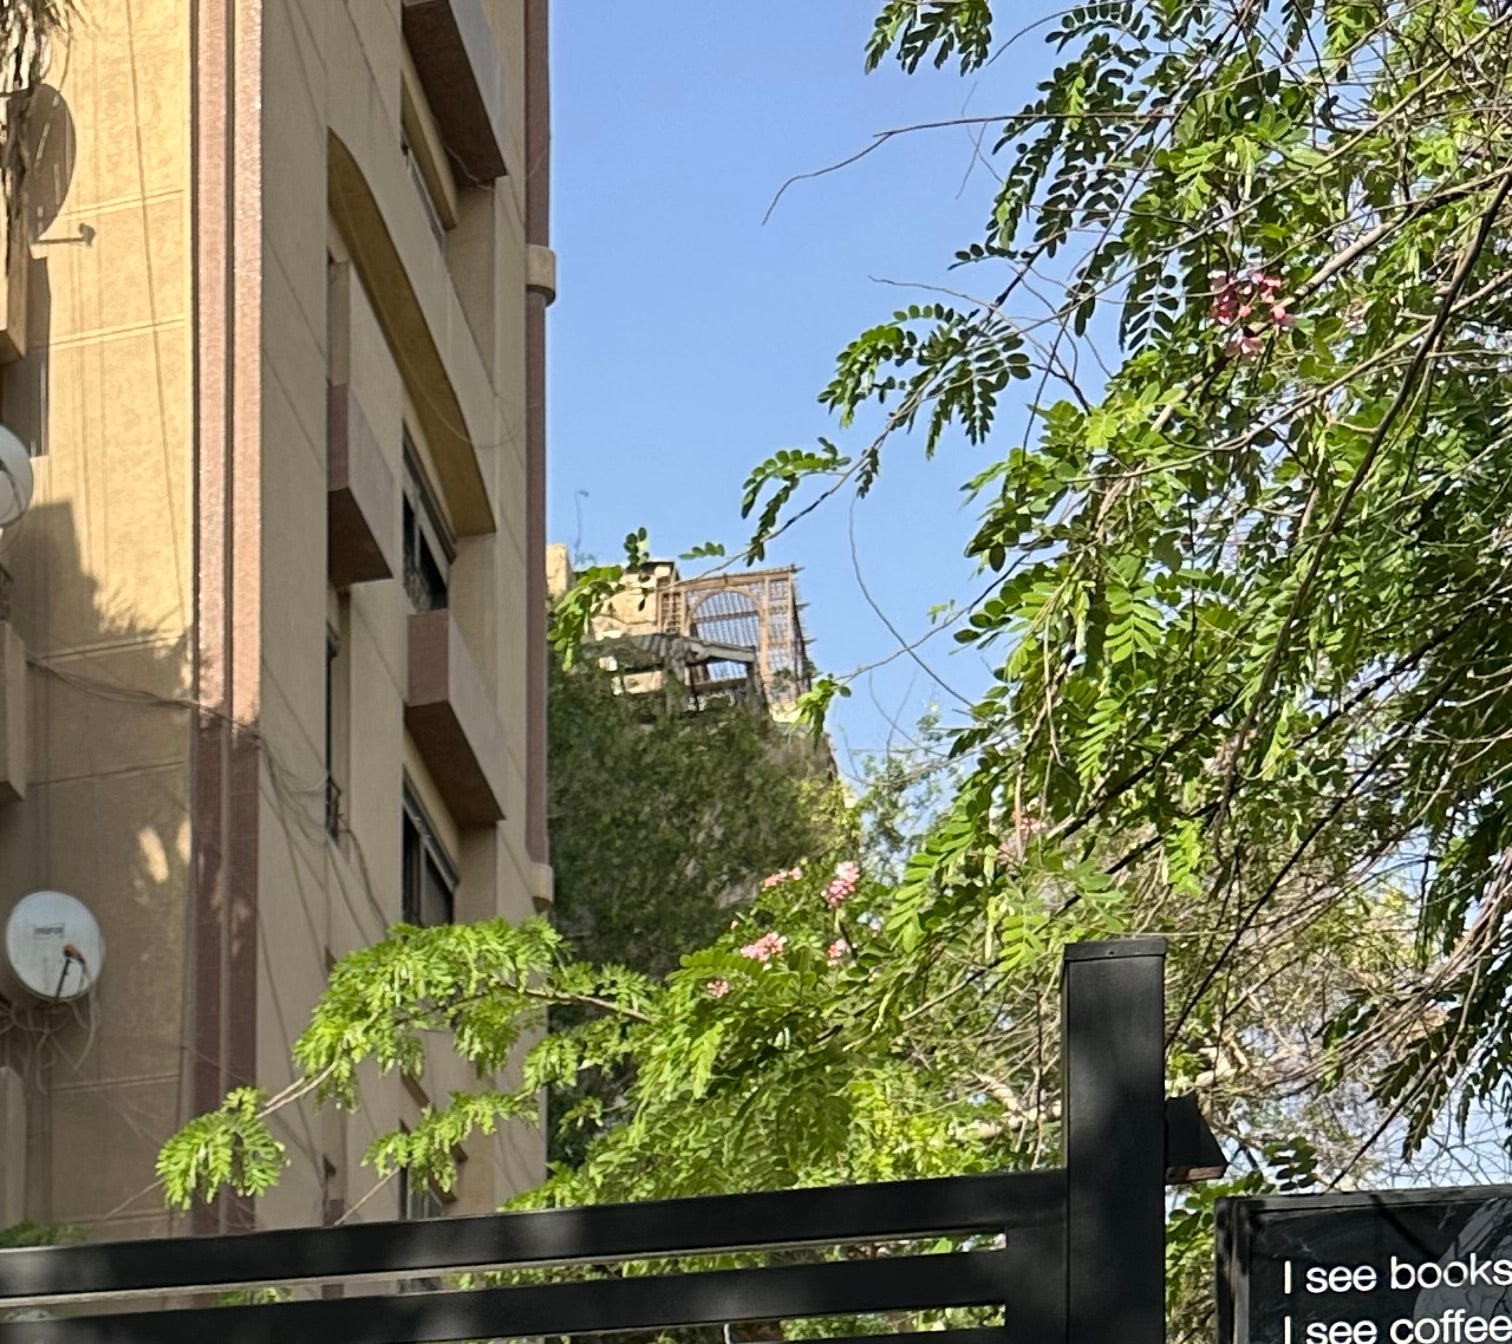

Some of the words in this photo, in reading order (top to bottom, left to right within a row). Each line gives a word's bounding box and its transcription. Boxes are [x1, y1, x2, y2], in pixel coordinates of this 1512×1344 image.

[1284, 1260, 1292, 1294] I
[1306, 1265, 1377, 1294] see
[1390, 1252, 1512, 1290] books
